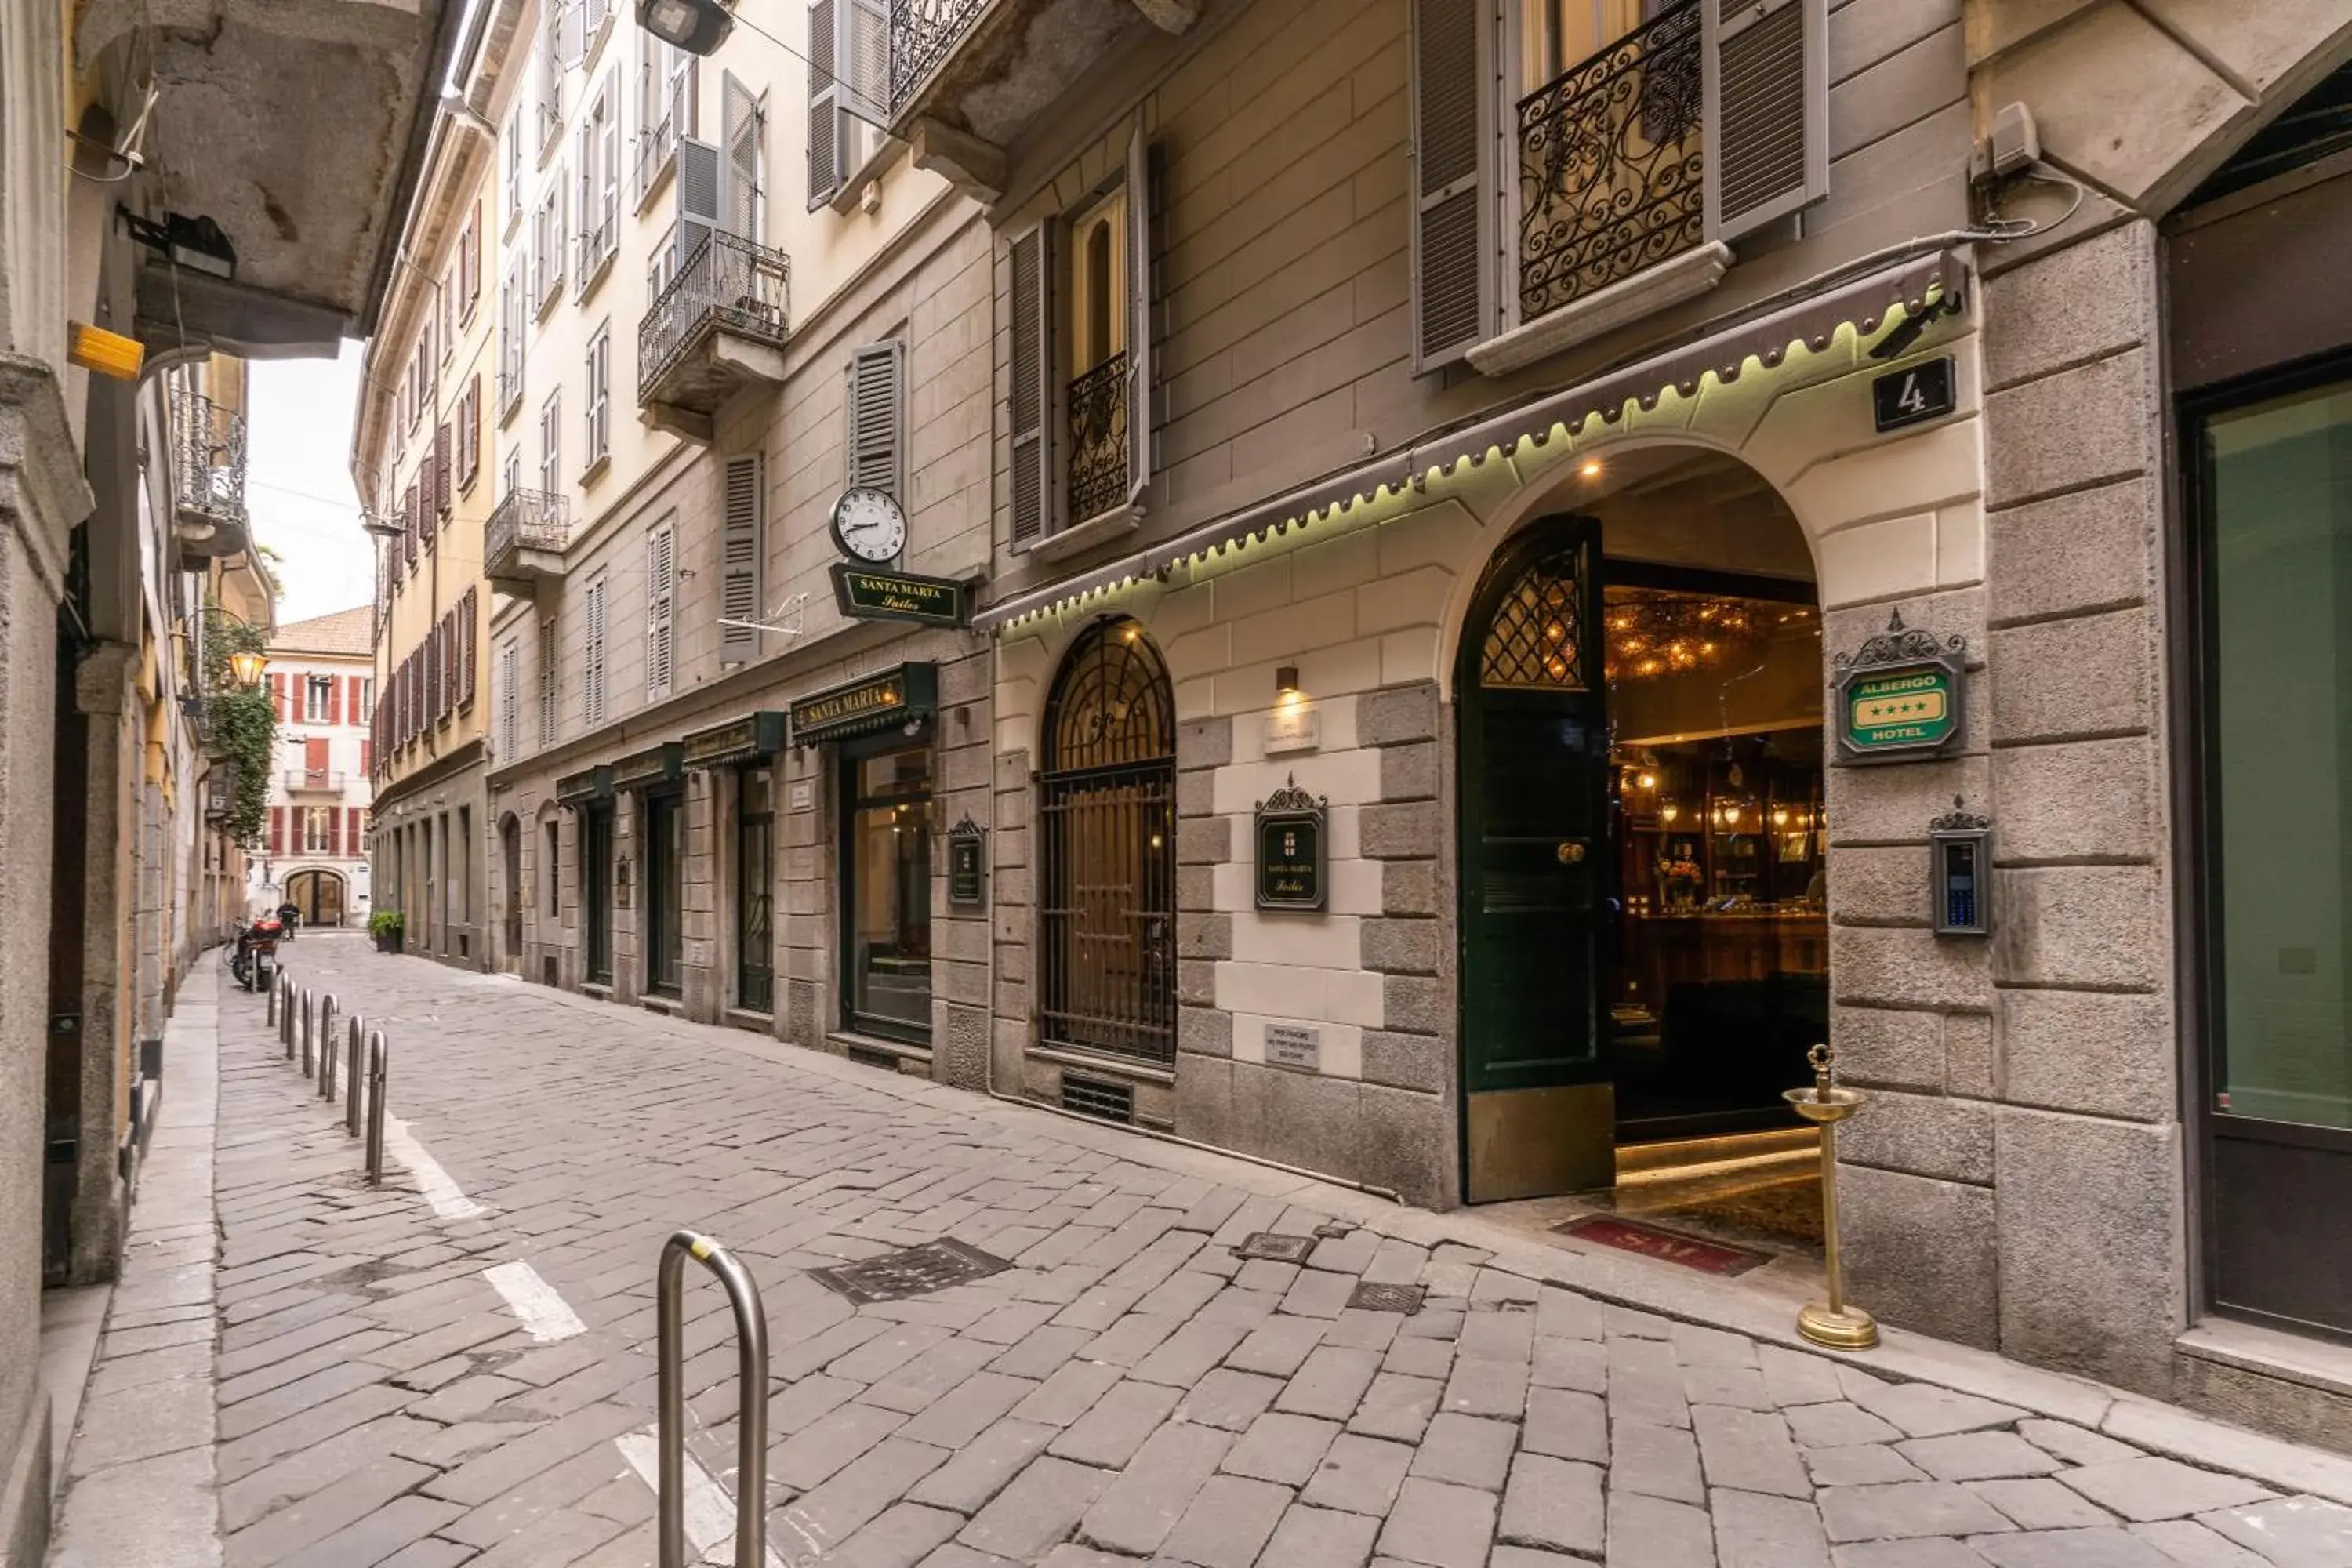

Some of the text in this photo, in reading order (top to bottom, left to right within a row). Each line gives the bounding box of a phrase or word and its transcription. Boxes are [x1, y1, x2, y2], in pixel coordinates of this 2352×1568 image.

[1898, 372, 1926, 412] 4
[860, 579, 941, 598] SANTA MARTA
[1861, 675, 1936, 694] ALBERGO
[808, 688, 881, 721] SANTA MARTA
[1872, 728, 1926, 741] HOTEL
